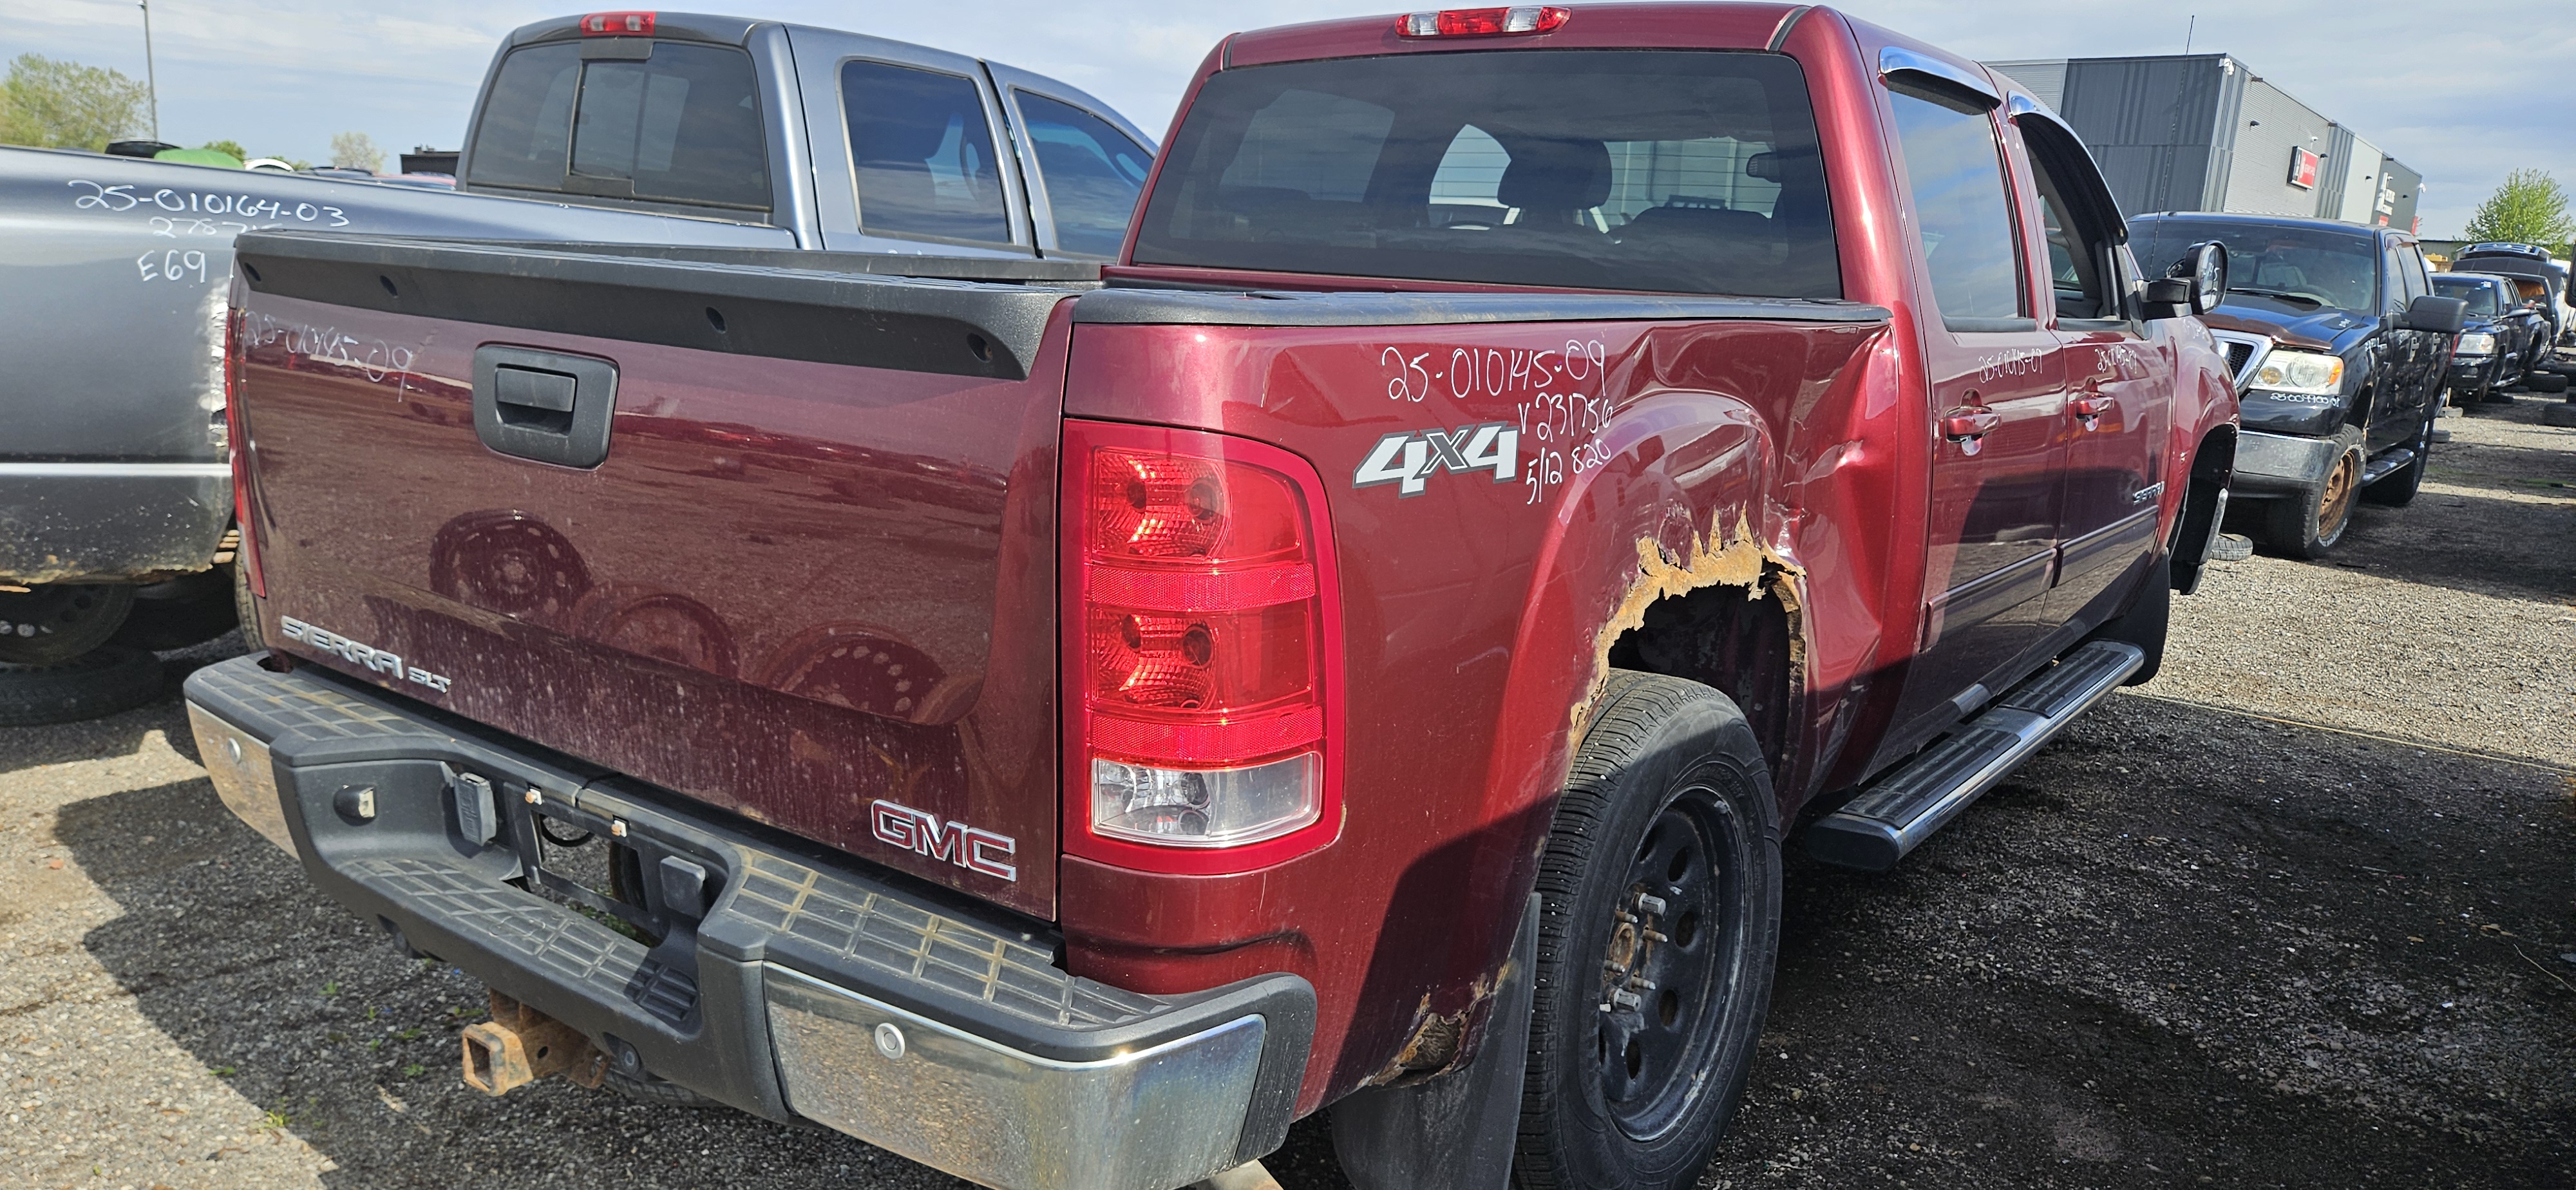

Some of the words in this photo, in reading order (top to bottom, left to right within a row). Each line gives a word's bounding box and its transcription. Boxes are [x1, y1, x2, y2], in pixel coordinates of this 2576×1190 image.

[68, 179, 350, 227] 25-010164-03
[149, 216, 283, 238] 2787
[1571, 439, 1611, 474] 820
[281, 614, 404, 679] SIERRA
[408, 666, 451, 694] SLT
[871, 799, 1017, 882] GMC
